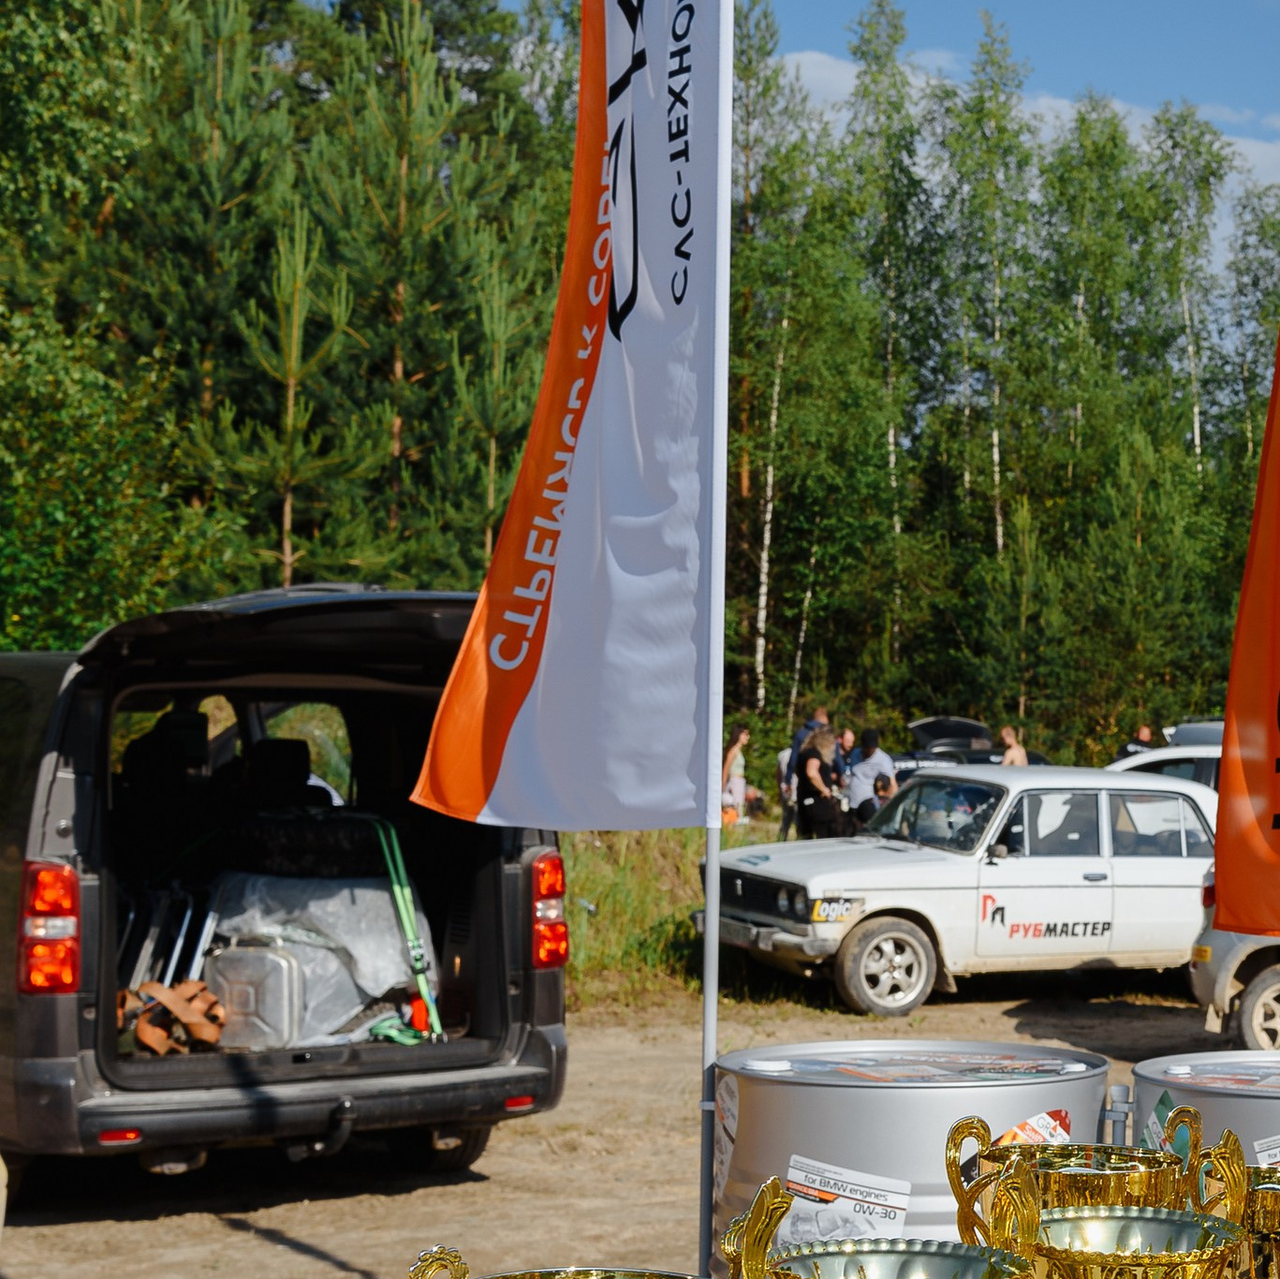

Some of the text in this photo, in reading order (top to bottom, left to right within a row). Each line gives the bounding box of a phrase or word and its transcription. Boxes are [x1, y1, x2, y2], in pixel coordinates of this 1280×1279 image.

[1009, 922, 1111, 939] РУБМАСТЕР
[1268, 1151, 1278, 1160] for
[804, 1174, 817, 1185] for
[819, 1178, 848, 1193] BMW
[849, 1186, 889, 1202] engines
[853, 1202, 897, 1220] 0W-30
